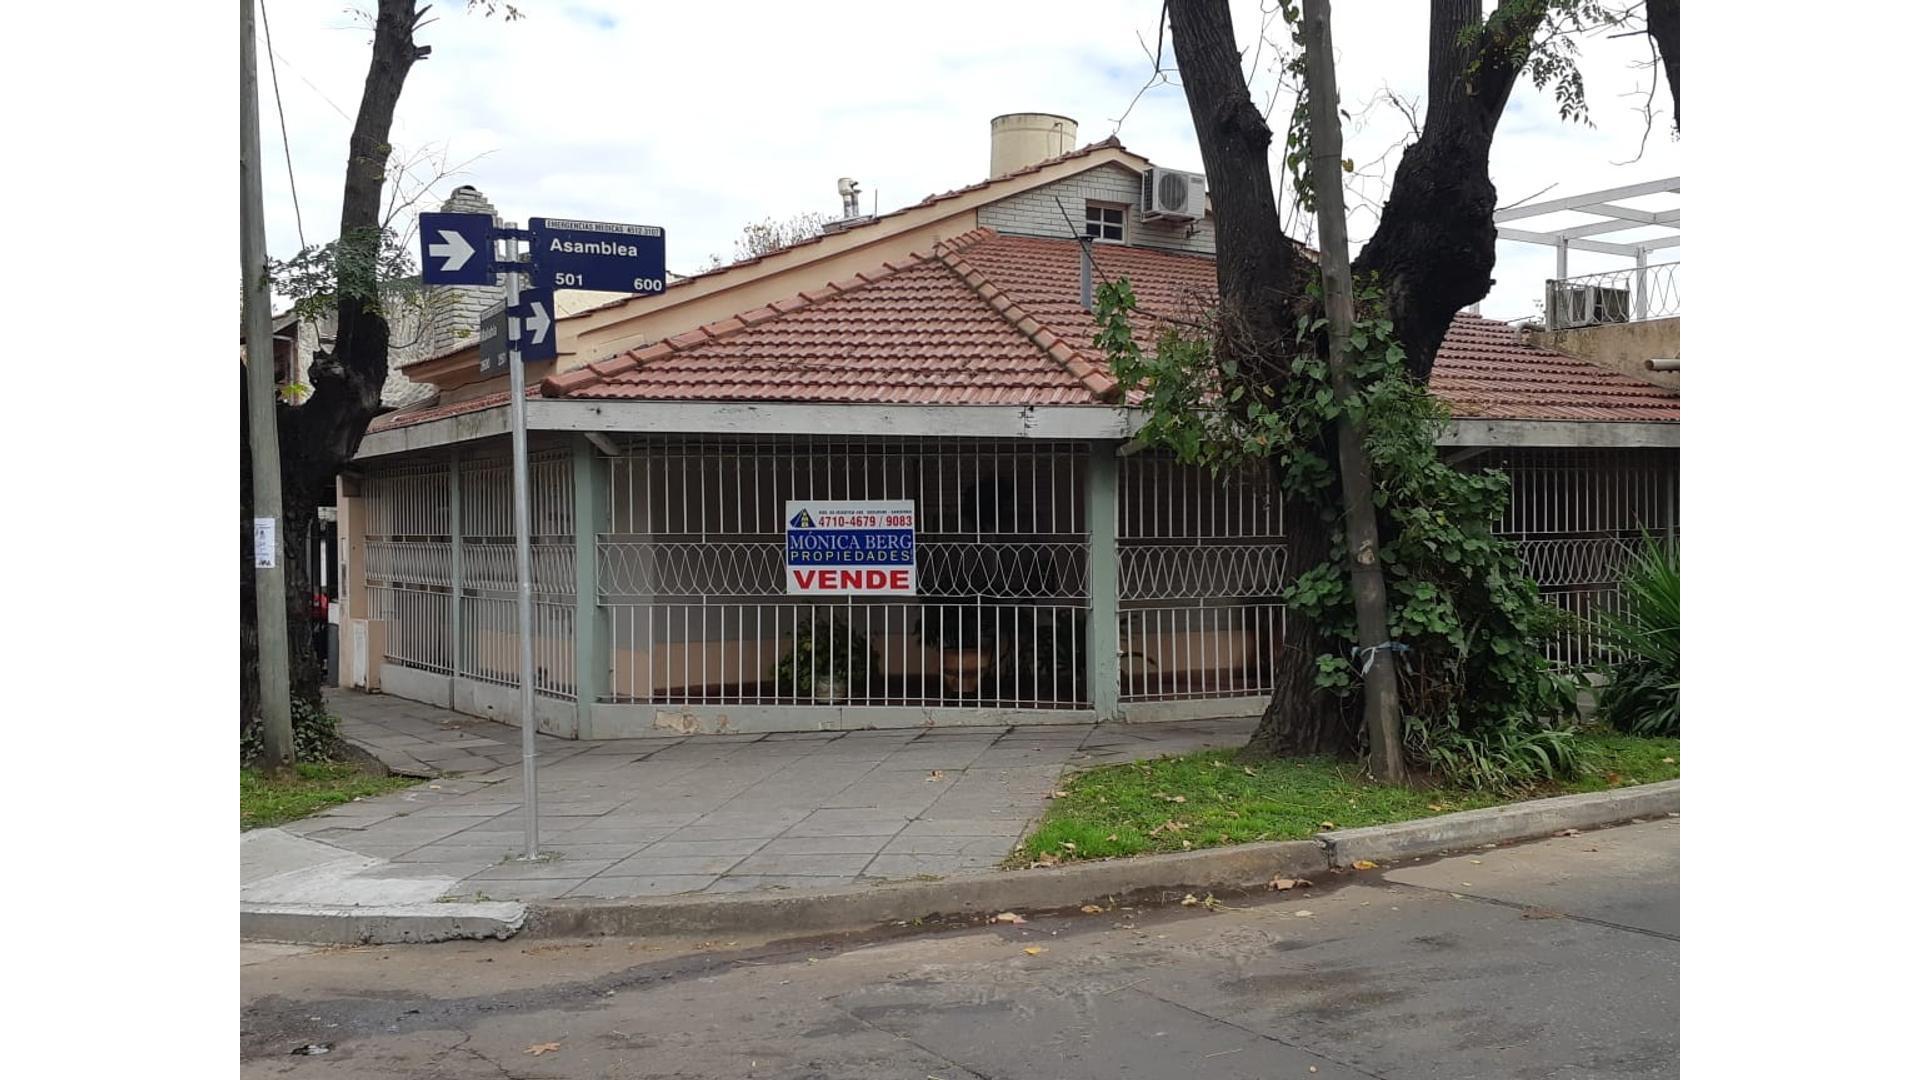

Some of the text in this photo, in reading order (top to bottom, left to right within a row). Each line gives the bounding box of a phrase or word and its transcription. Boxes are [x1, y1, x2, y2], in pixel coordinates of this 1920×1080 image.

[550, 238, 638, 257] Asamblea
[555, 272, 583, 286] 501
[633, 278, 662, 291] 600
[818, 515, 876, 527] 4710-4679
[886, 515, 912, 527] 9083
[790, 531, 912, 550] MÓNICA BERG
[791, 551, 910, 561] PROPIEDADES
[793, 570, 910, 590] VENDE
